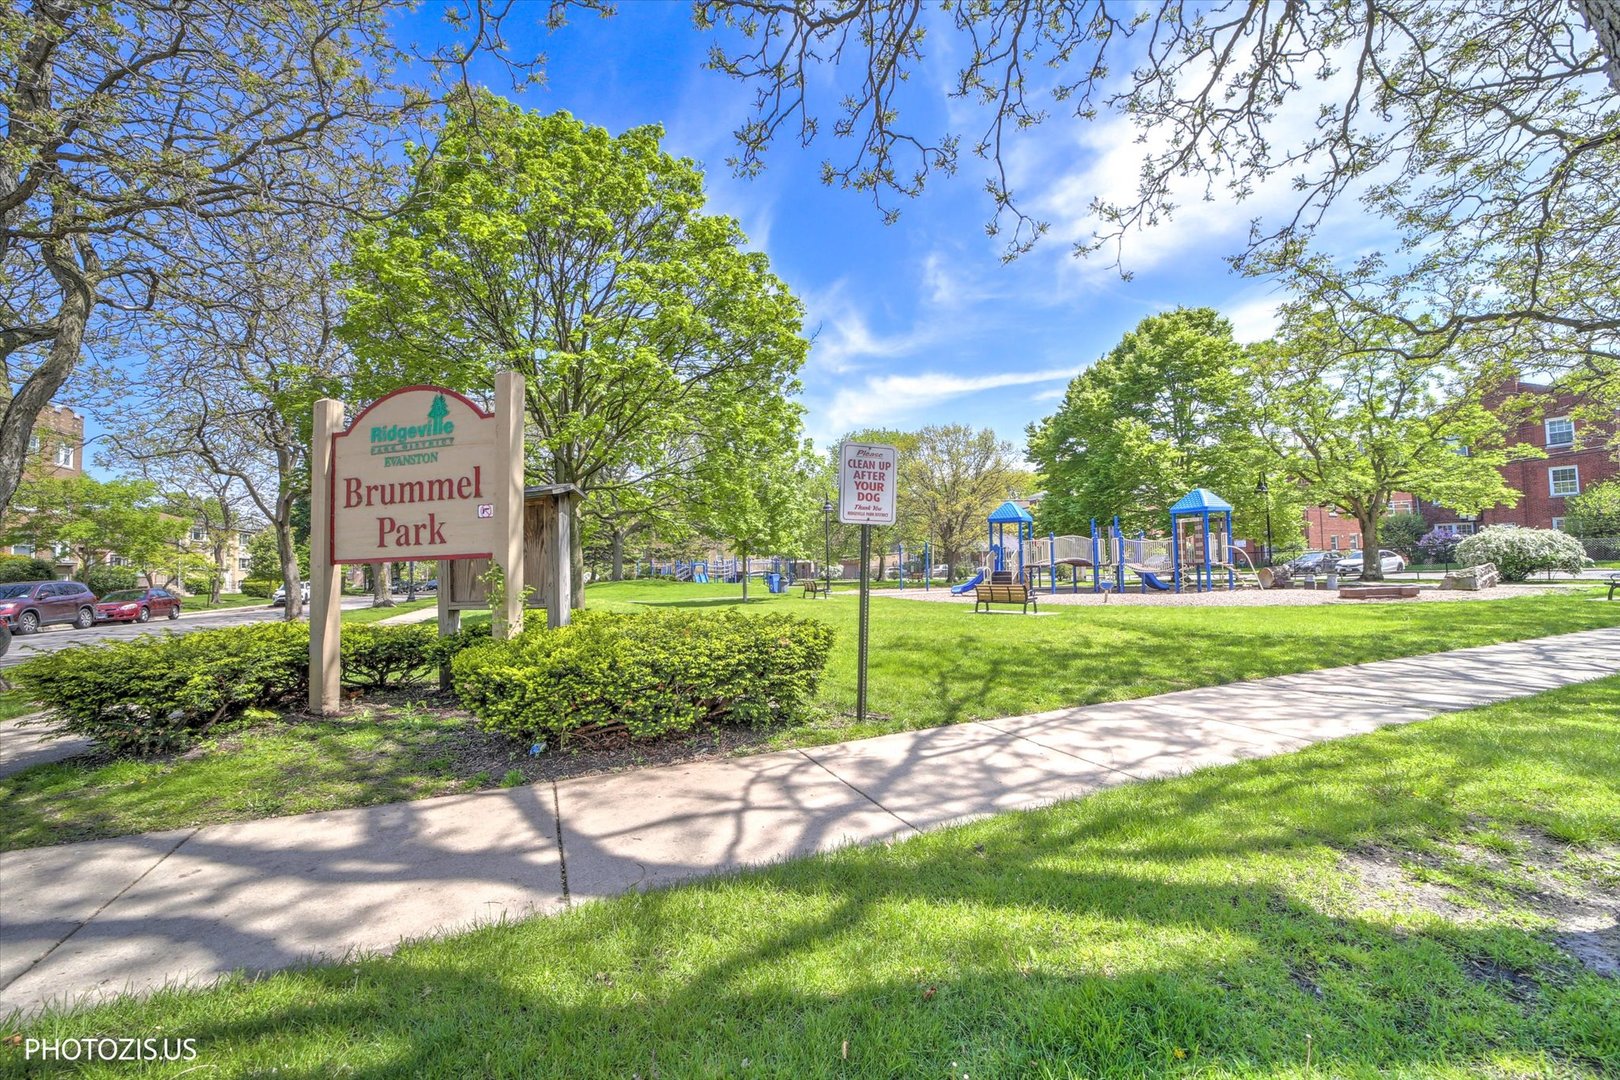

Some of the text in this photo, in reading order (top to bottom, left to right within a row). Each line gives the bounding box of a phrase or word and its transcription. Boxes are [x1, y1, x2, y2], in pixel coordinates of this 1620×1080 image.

[371, 420, 455, 446] Ridgeville
[384, 451, 439, 467] EVANSTON
[856, 449, 883, 458] Please
[848, 459, 891, 470] CLEAN UP
[853, 470, 885, 481] AFTER
[343, 466, 483, 508] Brummel
[854, 481, 885, 491] YOUR
[857, 492, 880, 502] DOG
[376, 513, 447, 548] Park
